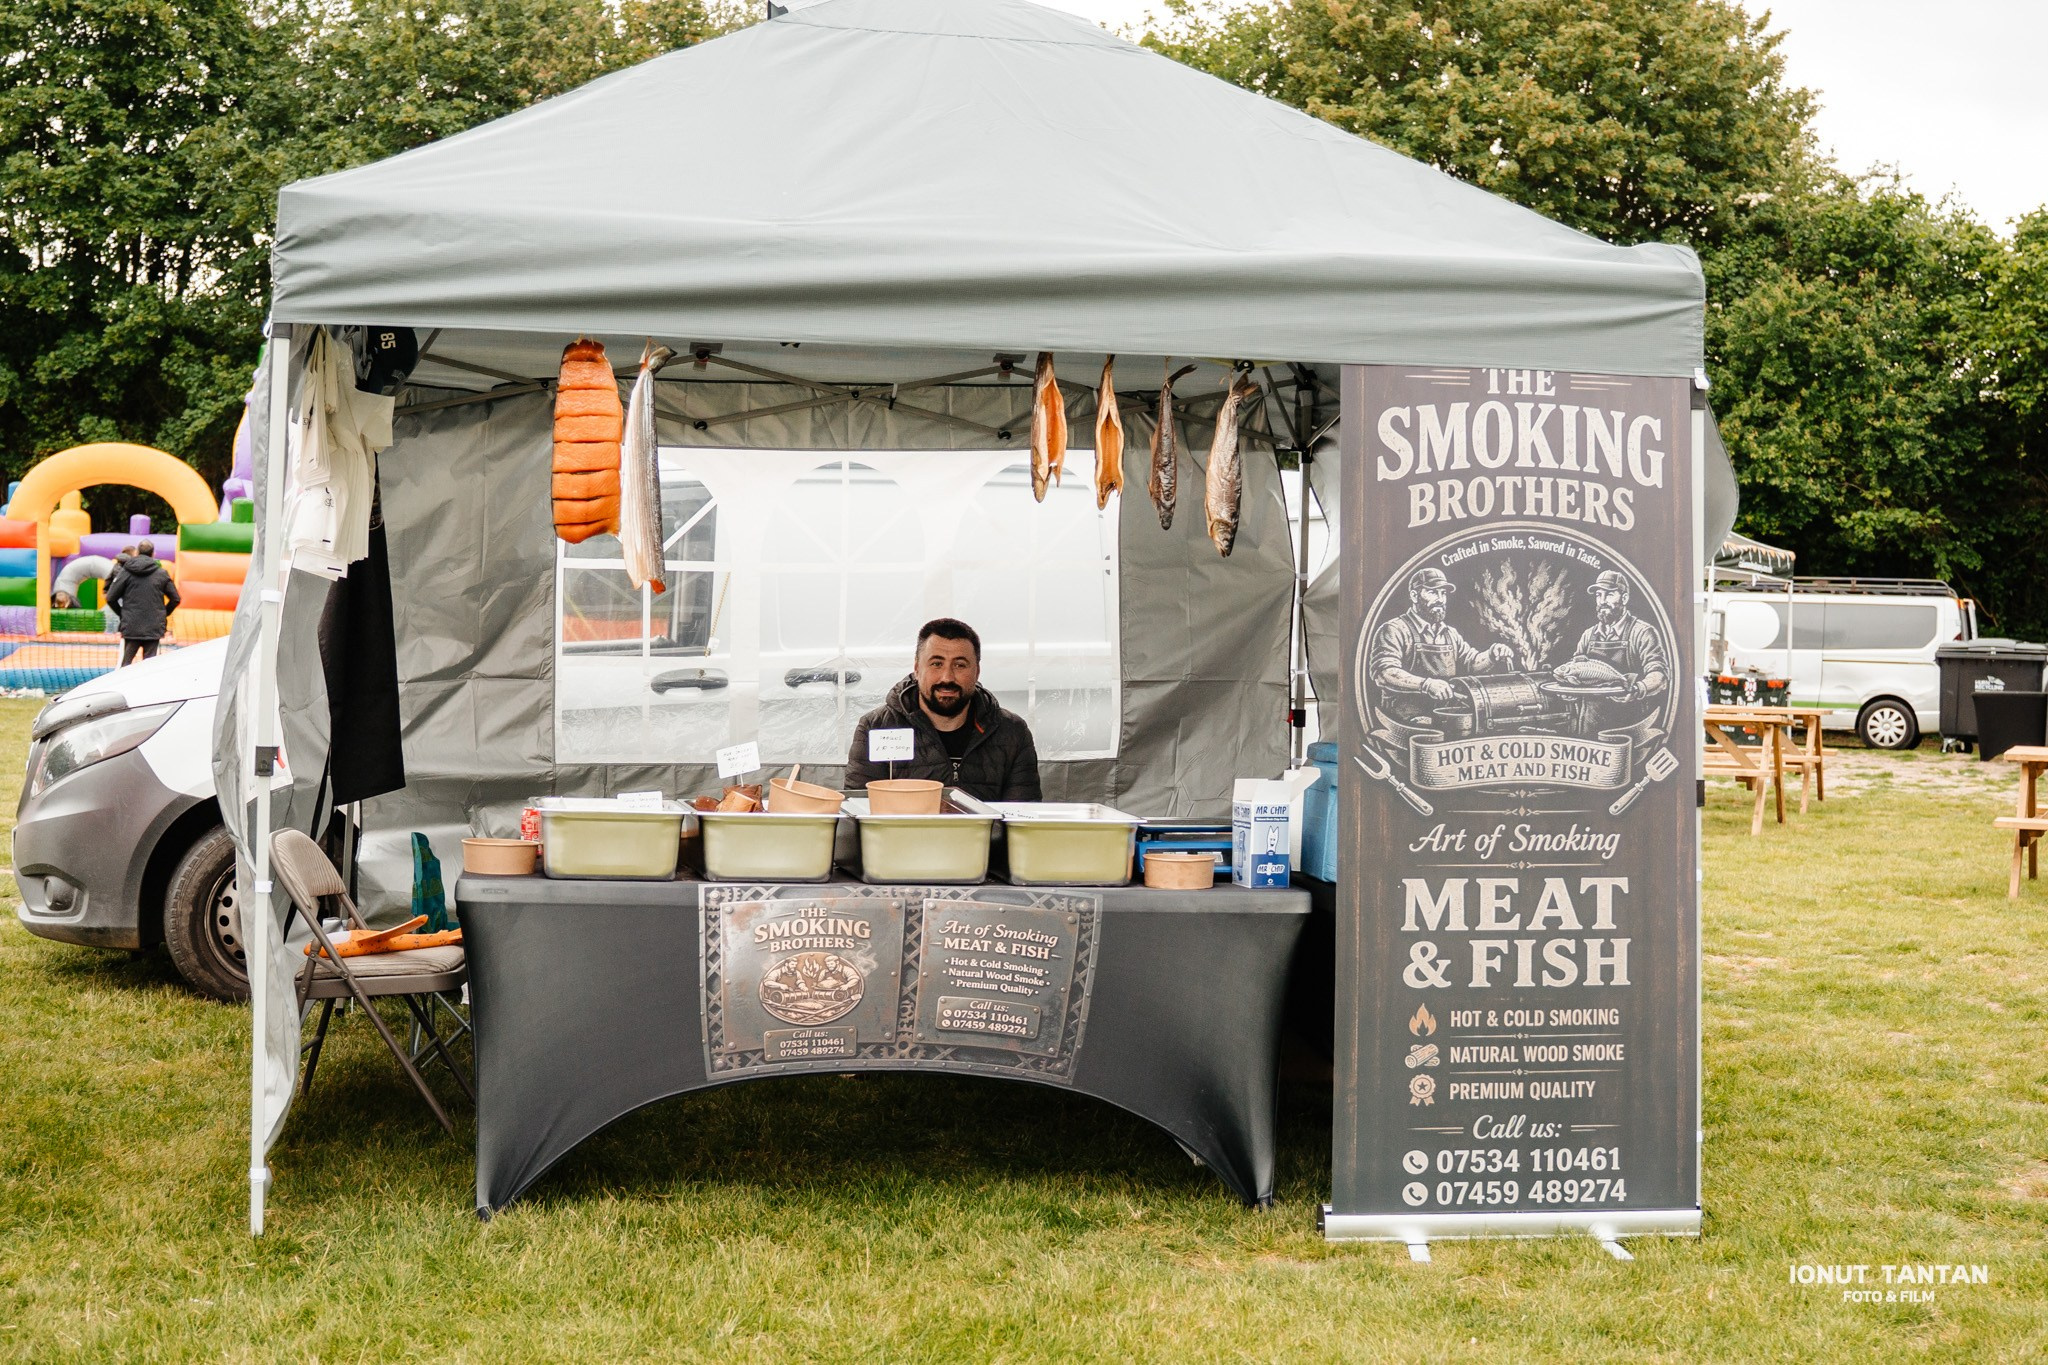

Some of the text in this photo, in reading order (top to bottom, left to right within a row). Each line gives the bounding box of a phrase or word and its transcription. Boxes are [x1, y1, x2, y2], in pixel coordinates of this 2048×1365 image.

[381, 333, 396, 349] 85
[1482, 368, 1556, 397] THE
[1377, 401, 1665, 488] SMOKING
[1407, 476, 1635, 531] BROTHERS
[1441, 536, 1601, 570] Crafted in Smoke, Savored in Taste.
[1437, 742, 1612, 767] HOT & COLD SMOKE
[1458, 763, 1591, 782] MEAT AND FISH
[1256, 806, 1287, 815] MR CHIP
[1409, 823, 1621, 860] Art of Smoking
[798, 907, 827, 918] THE
[1400, 877, 1629, 931] MEAT
[754, 918, 871, 944] SMOKING
[938, 920, 1059, 948] Art of Smoking
[770, 937, 855, 953] BROTHERS
[944, 937, 1050, 960] MEAT & FISH
[950, 957, 1044, 977] Hot & Cold Smoking
[1402, 938, 1631, 989] & FISH
[948, 968, 1044, 987] Natural Wood Smoke
[956, 979, 1034, 997] Premium Quality
[970, 1000, 1009, 1013] Call us:
[953, 1009, 1028, 1025] 07534 110461
[1450, 1008, 1620, 1027] HOT & COLD SMOKING
[792, 1030, 813, 1039] Call
[952, 1020, 1027, 1035] 07459 489274
[779, 1038, 845, 1049] 07534 110461
[780, 1046, 845, 1057] 07459 489274
[1450, 1044, 1625, 1063] NATURAL WOOD SMOKE
[1450, 1081, 1596, 1101] PREMIUM QUALITY
[1472, 1114, 1562, 1140] Call us:
[1436, 1147, 1620, 1173] 07534 110461
[1436, 1179, 1627, 1205] 07459 489274
